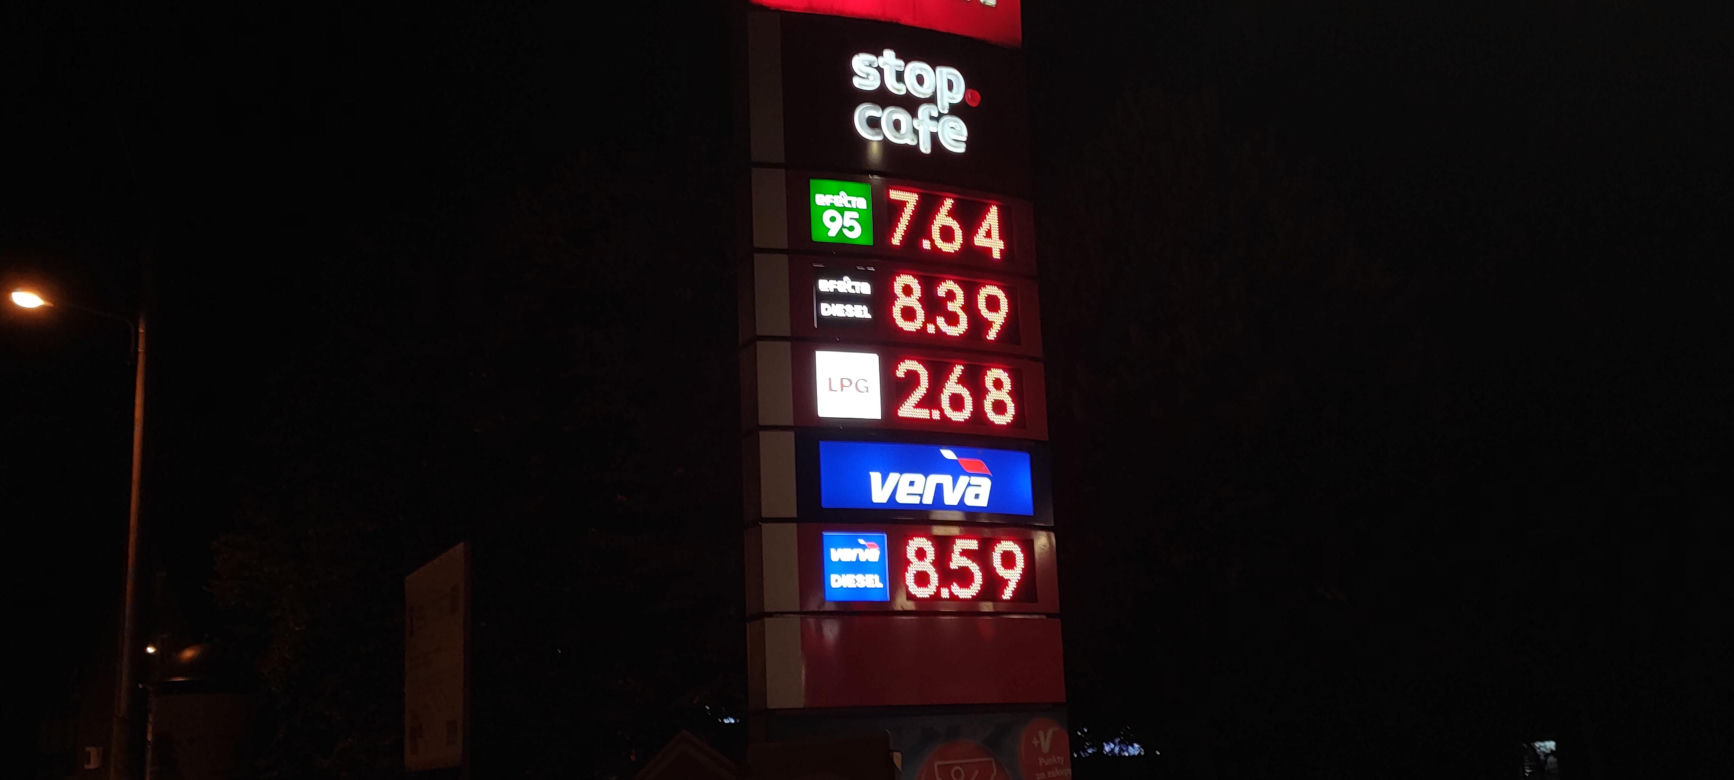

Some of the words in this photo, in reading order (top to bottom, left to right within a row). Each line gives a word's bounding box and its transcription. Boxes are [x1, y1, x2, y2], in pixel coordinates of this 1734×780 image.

[854, 102, 968, 154] cafe
[822, 209, 862, 239] 95
[889, 189, 1005, 259] 7.64
[820, 303, 872, 318] DIESEL
[892, 274, 1009, 340] 8.39
[828, 377, 869, 394] LPG
[896, 360, 1015, 425] 2.68
[869, 472, 992, 507] verva
[830, 574, 883, 588] DIESEL
[905, 537, 1025, 599] 8.59
